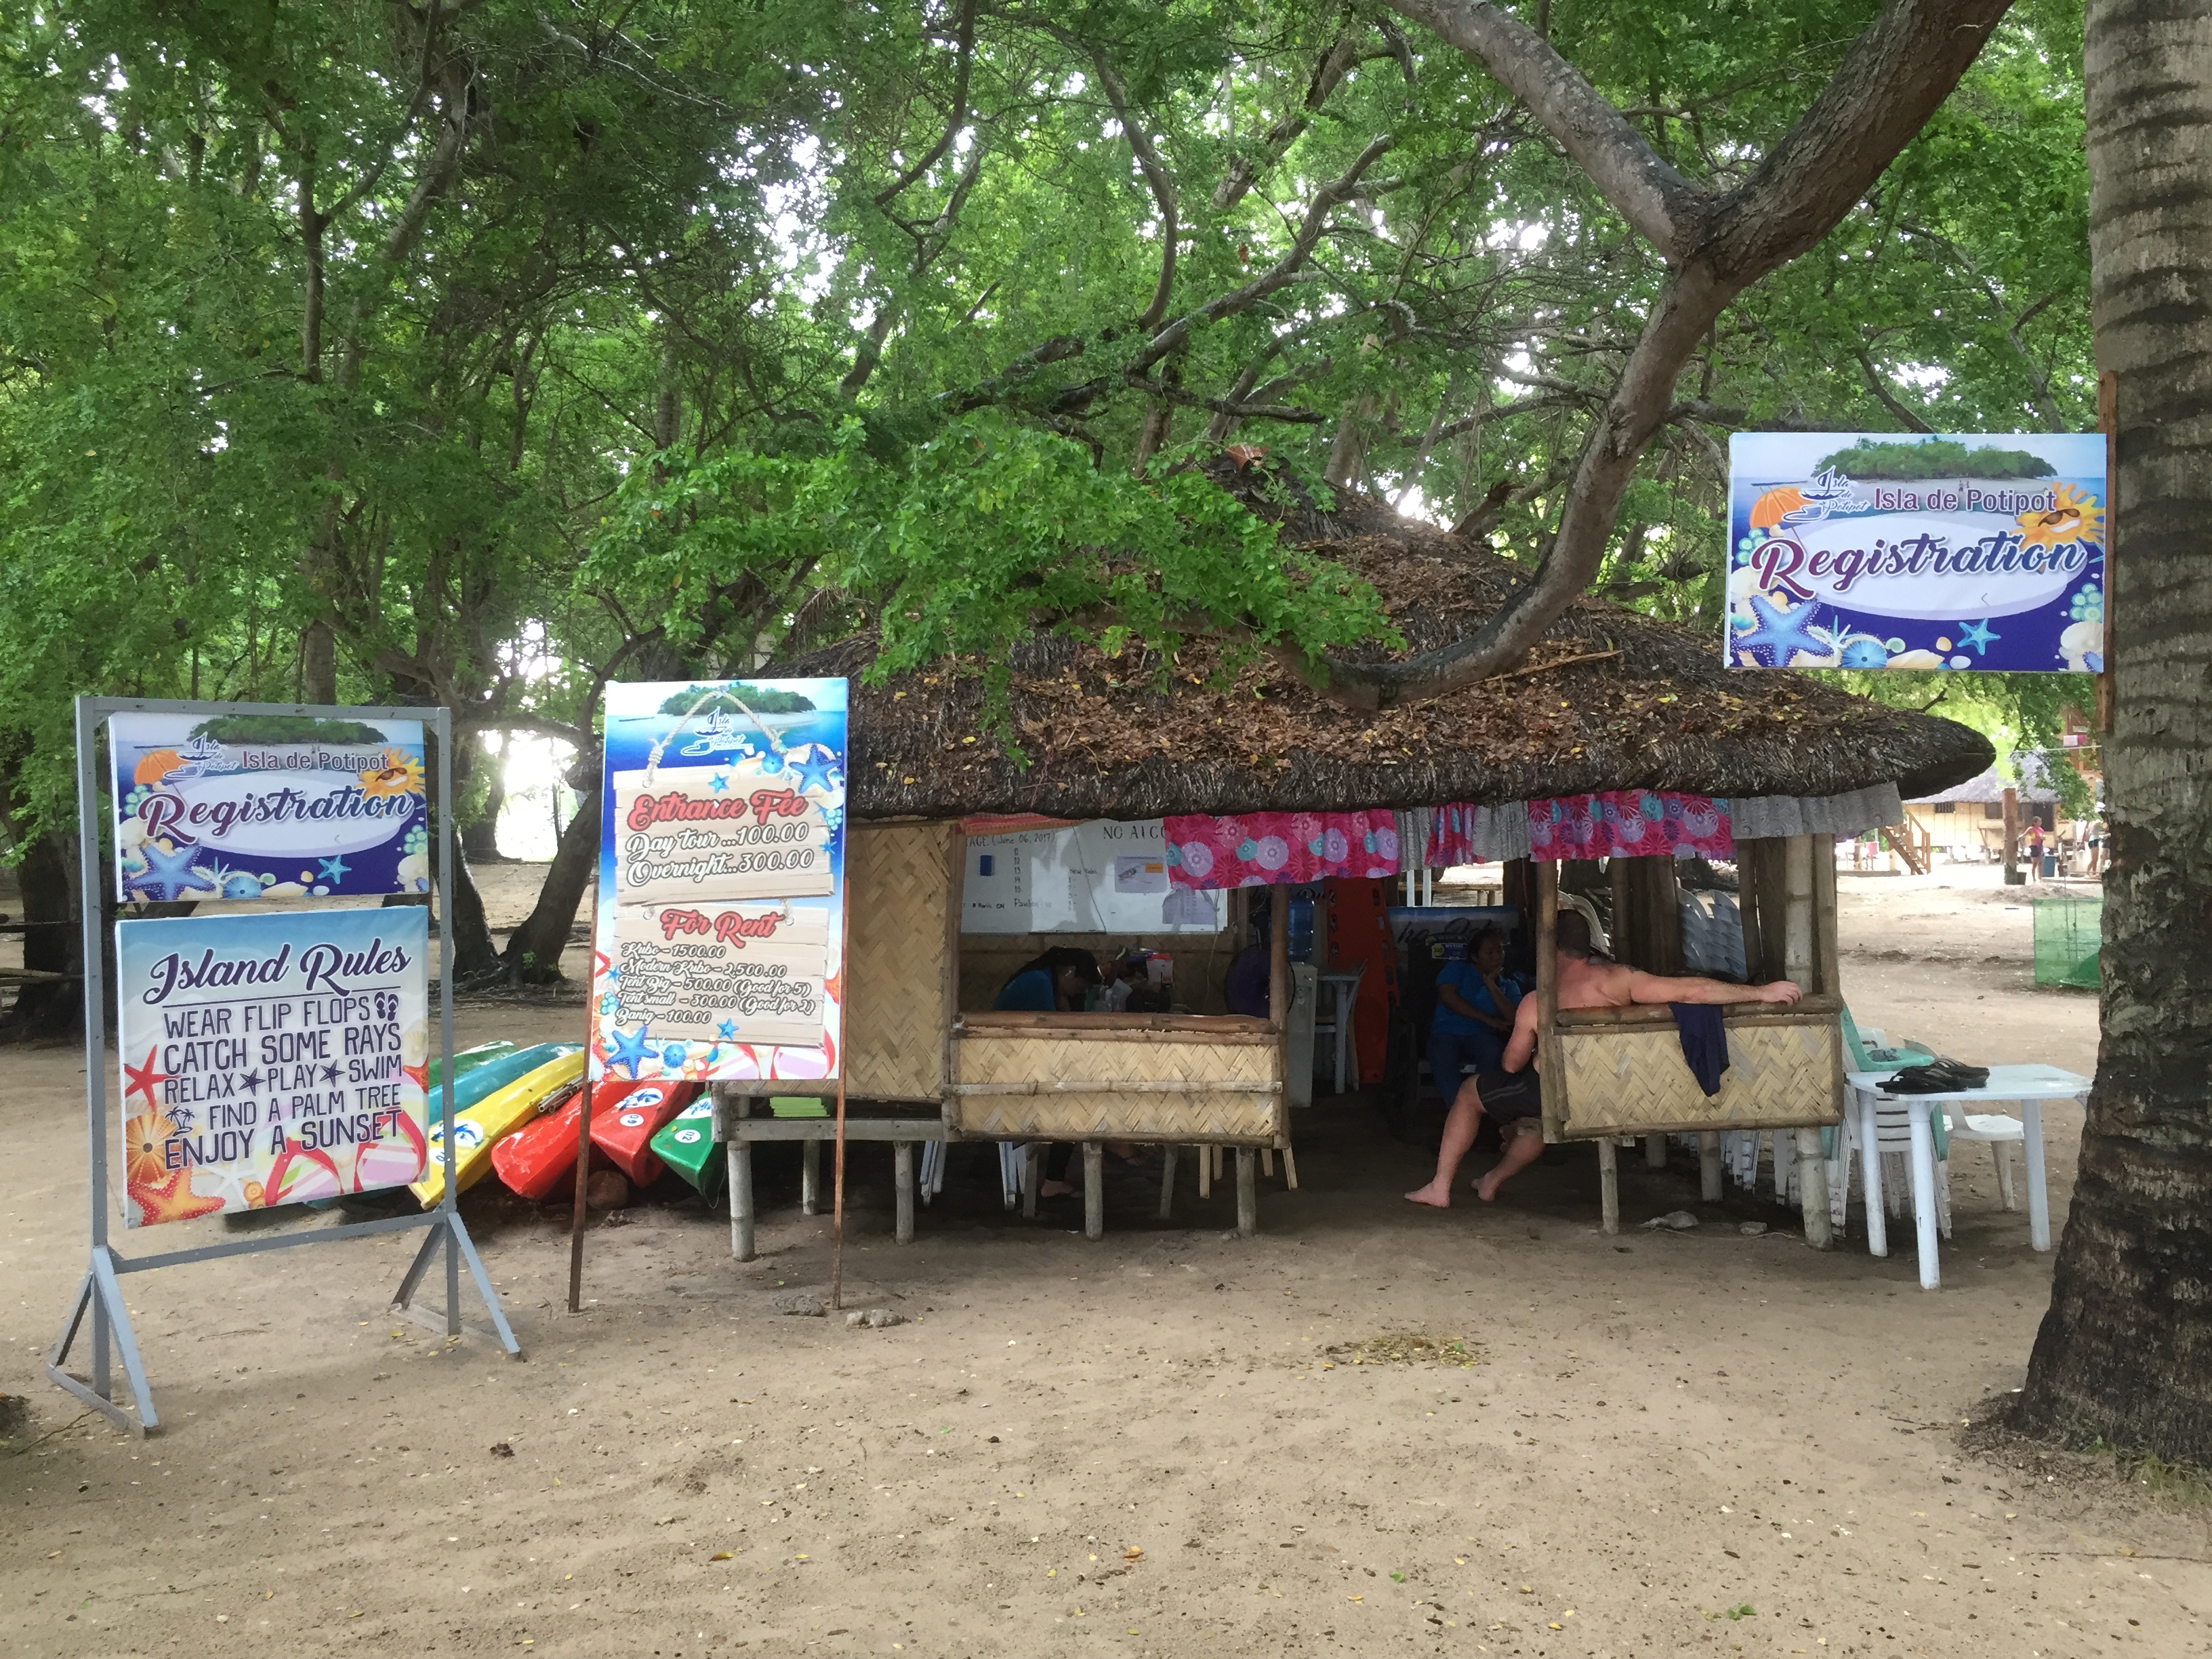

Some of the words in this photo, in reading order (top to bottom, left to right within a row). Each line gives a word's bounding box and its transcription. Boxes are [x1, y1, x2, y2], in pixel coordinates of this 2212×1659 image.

[1875, 487, 1919, 511] Isla
[1927, 488, 1957, 511] de
[1967, 489, 2057, 514] Potipot
[1750, 530, 2087, 599] Registration
[243, 750, 279, 769] Isla
[285, 751, 311, 769] de
[318, 752, 388, 774] Potipot
[138, 785, 415, 844] Registration
[627, 791, 747, 832] Entrance
[749, 788, 809, 825] Fee
[625, 832, 678, 864] Day
[678, 827, 720, 850] tour
[1103, 825, 1123, 840] NO
[659, 908, 712, 941] For
[714, 911, 786, 948] Rent
[619, 958, 673, 975] Modern
[673, 960, 712, 977] Kubo
[621, 941, 660, 959] Kubo
[672, 944, 726, 958] 1500.00
[142, 943, 291, 1005] Island
[300, 937, 411, 997] Rules
[618, 974, 647, 990] Tent
[646, 975, 672, 994] Big
[683, 978, 732, 991] 500.00
[733, 979, 775, 998] (Good
[771, 980, 792, 998] for
[163, 1008, 230, 1039] WEAR
[245, 1002, 291, 1033] FLIP
[304, 996, 370, 1027] FLOPS
[617, 989, 645, 1006] Tent
[644, 991, 677, 1006] small
[690, 994, 737, 1008] 300.00
[738, 996, 779, 1016] (Good
[776, 997, 798, 1015] for
[666, 1008, 712, 1024] 100.00
[163, 1039, 247, 1075] CATCH
[261, 1029, 331, 1065] SOME
[344, 1022, 402, 1055] RAYS
[165, 1071, 235, 1105] RELAX
[268, 1063, 317, 1092] PLAY
[348, 1054, 403, 1083] SWIM
[209, 1101, 257, 1130] FIND
[268, 1097, 282, 1122] A
[291, 1090, 345, 1120] PALM
[355, 1083, 401, 1110] TREE
[165, 1128, 253, 1170] ENJOY
[270, 1124, 289, 1155] A
[301, 1108, 403, 1151] SUNSET
